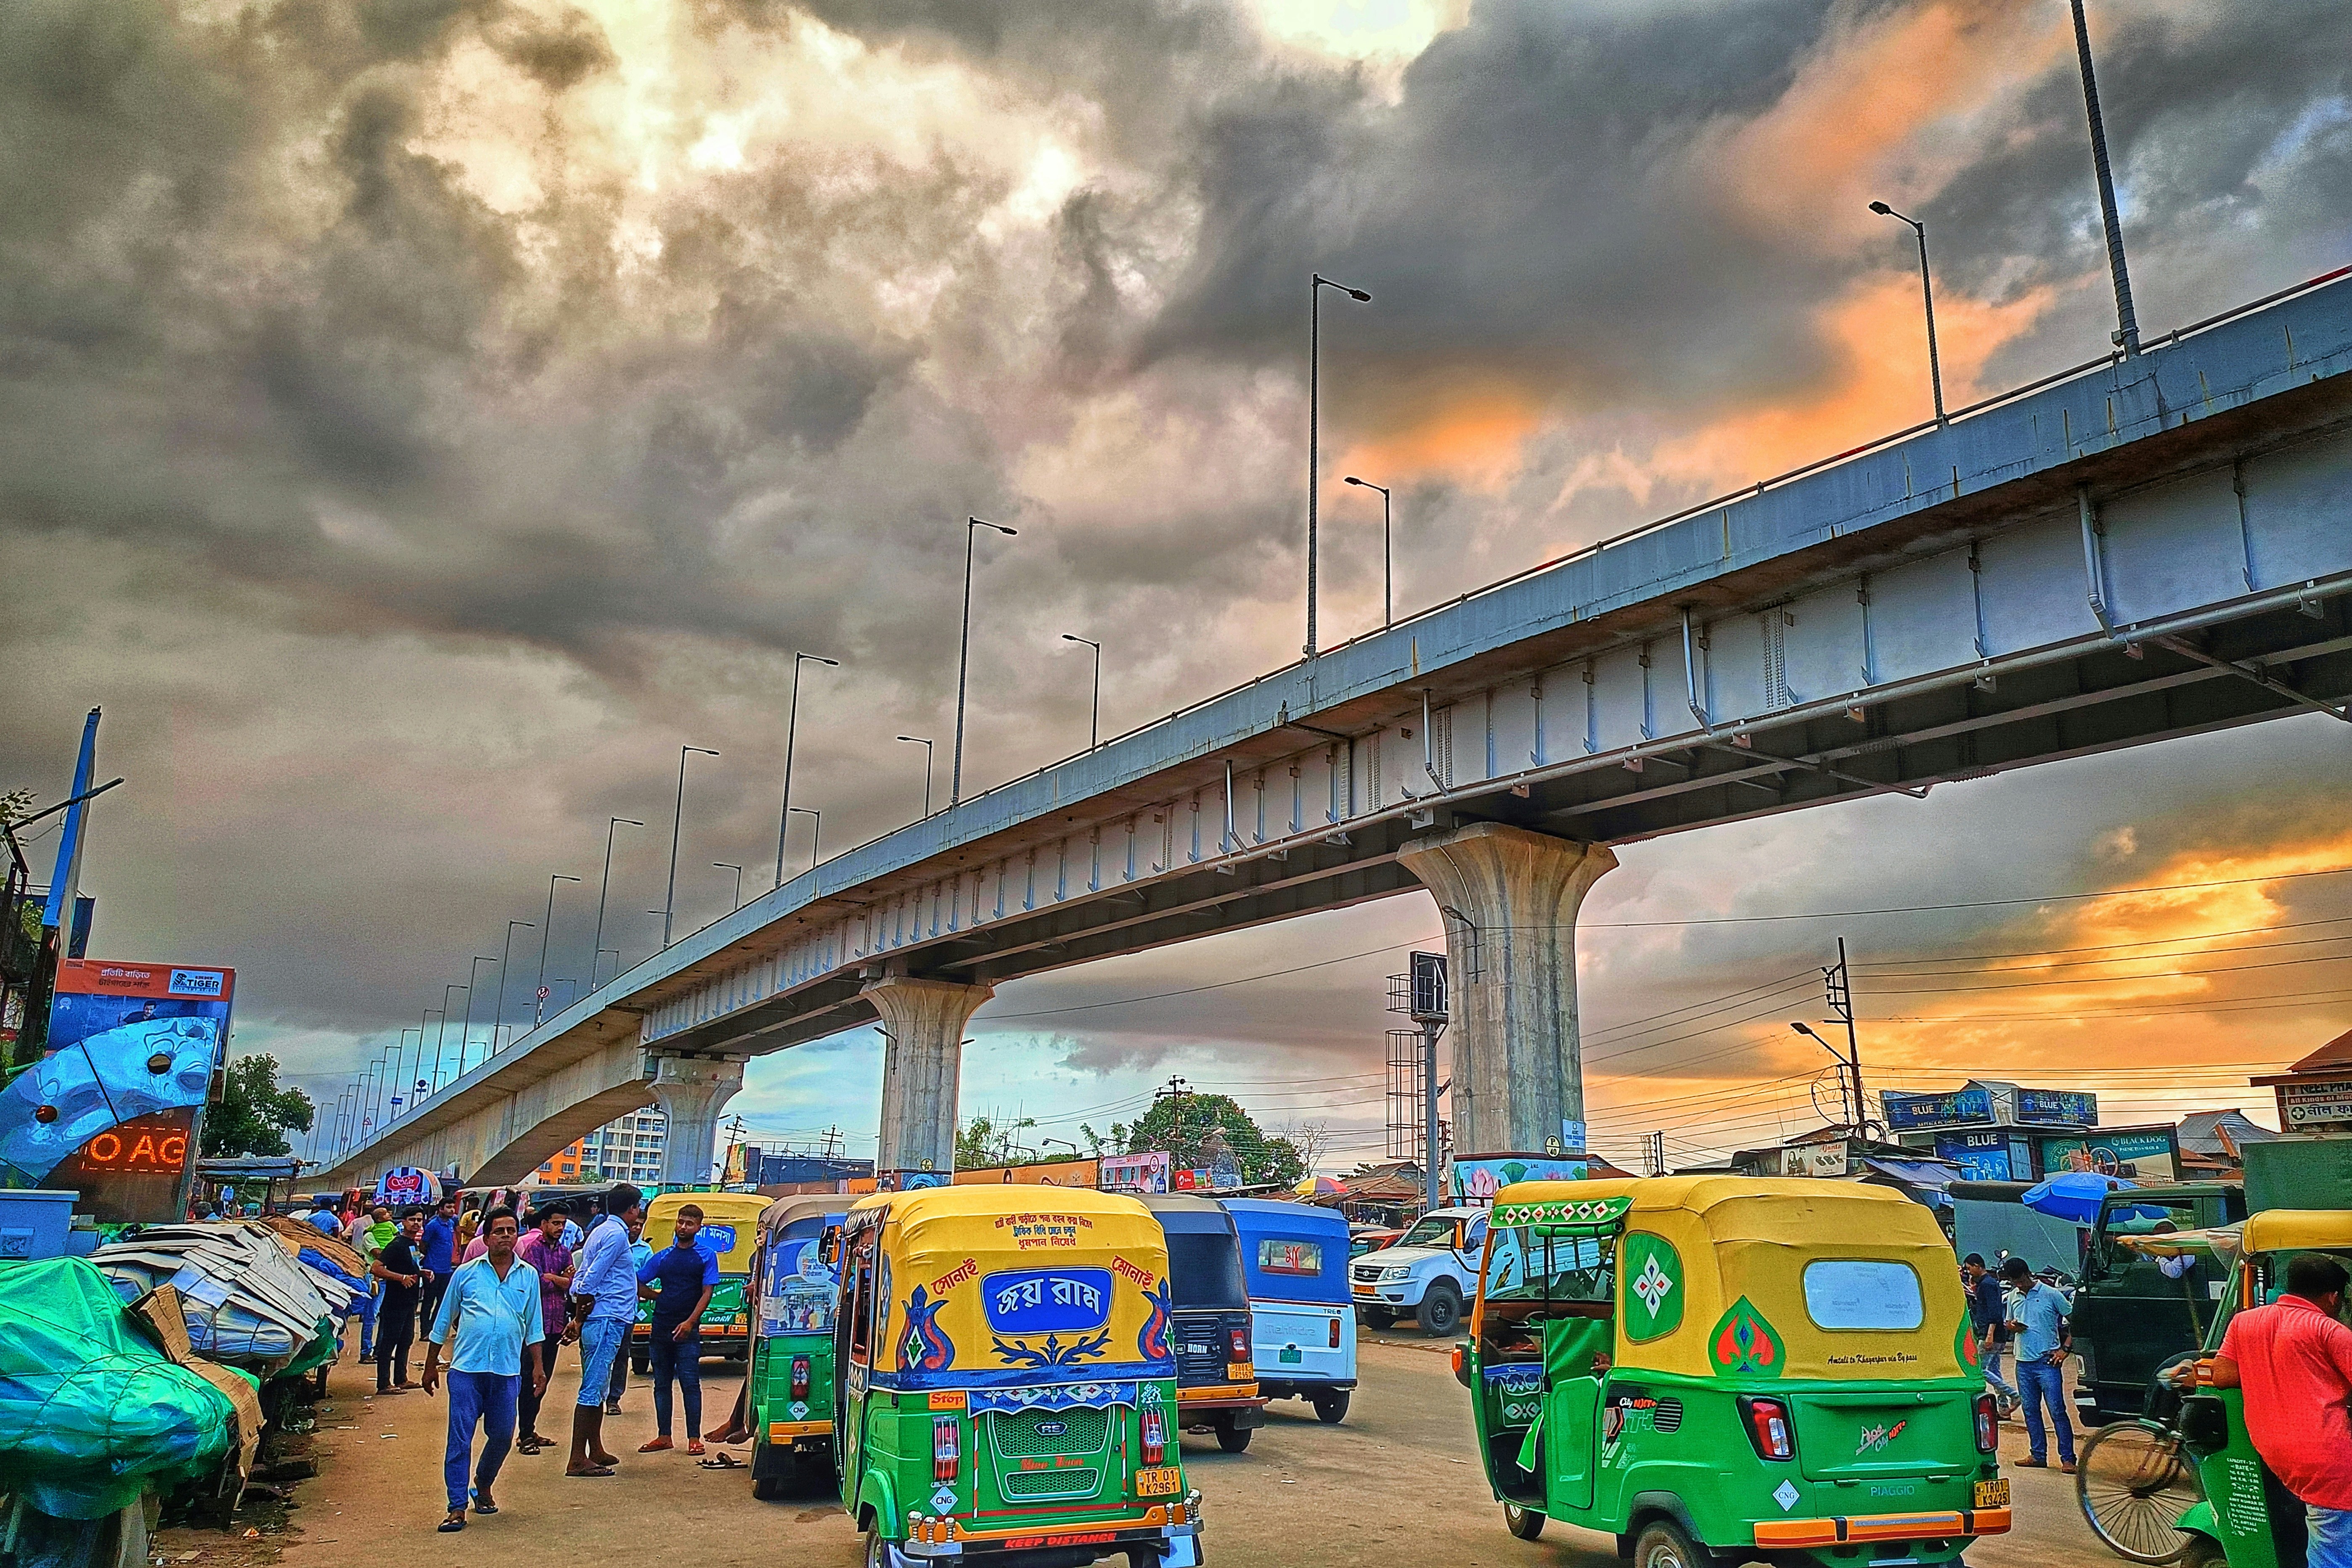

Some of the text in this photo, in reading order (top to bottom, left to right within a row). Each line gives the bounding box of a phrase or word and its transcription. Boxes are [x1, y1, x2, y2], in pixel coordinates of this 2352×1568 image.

[101, 968, 151, 979] প্রতিটি বাড়িতে
[187, 979, 219, 988] TIGER
[2300, 1084, 2328, 1094] NEEL
[1912, 1105, 1934, 1115] BLUE
[2039, 1101, 2059, 1109] BLUE
[2307, 1104, 2332, 1116] নীল
[1967, 1134, 1998, 1147] BLUE
[2121, 1136, 2145, 1145] BLACK
[709, 1227, 731, 1244] মনসা
[1034, 1224, 1046, 1235] বিধি
[1063, 1226, 1076, 1238] চলুন
[1019, 1236, 1076, 1250] ধূমপান নিষেধ
[931, 1255, 1155, 1295] সোনাই মোনাই
[997, 1277, 1101, 1315] জয় রাম
[1187, 1343, 1207, 1354] HORN
[931, 1392, 964, 1405] Stop
[1619, 1397, 1633, 1409] City
[1145, 1470, 1175, 1483] TR 01
[1146, 1481, 1176, 1495] K2961
[1870, 1485, 1914, 1497] PIAGGIO
[1984, 1481, 2004, 1494] TR01
[936, 1496, 953, 1505] CNG
[1004, 1533, 1117, 1548] KEEP DISTANCE
